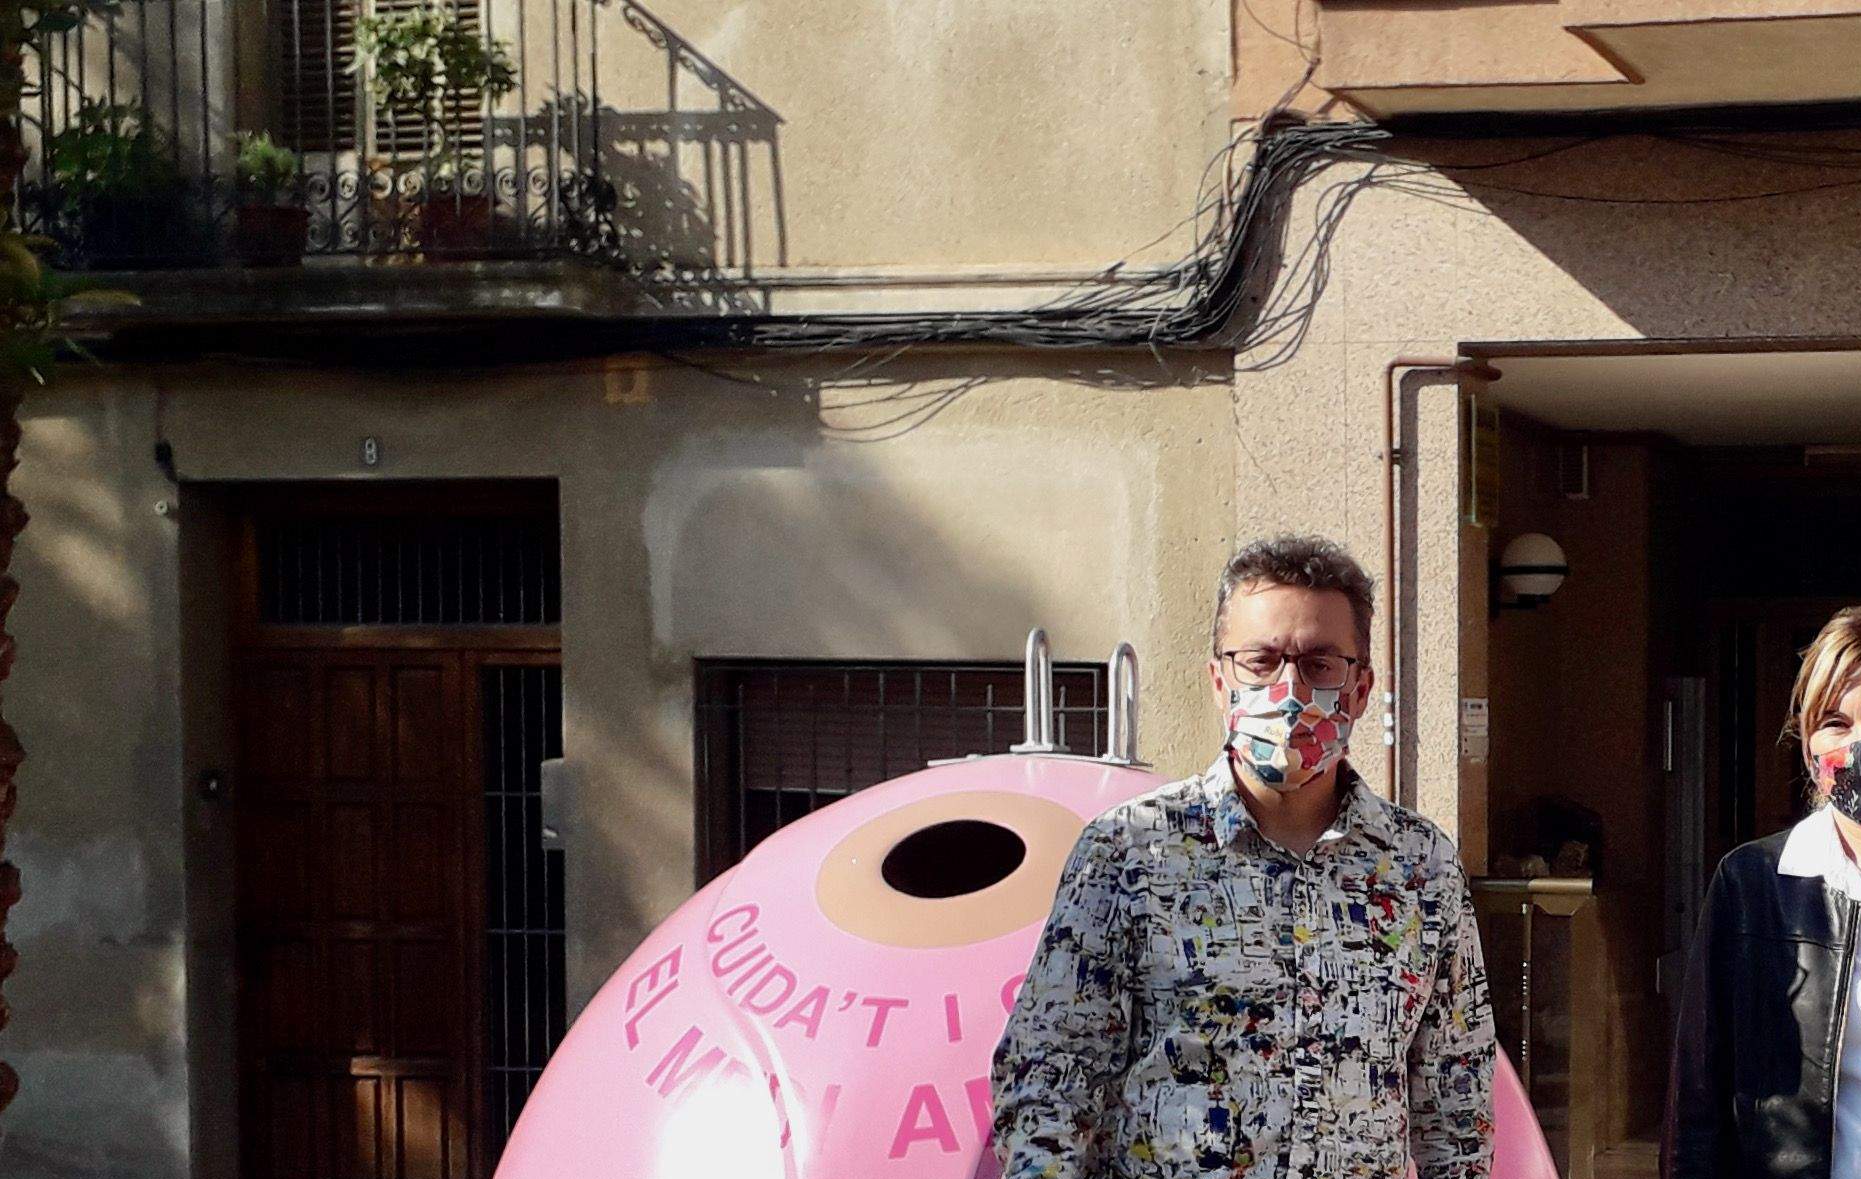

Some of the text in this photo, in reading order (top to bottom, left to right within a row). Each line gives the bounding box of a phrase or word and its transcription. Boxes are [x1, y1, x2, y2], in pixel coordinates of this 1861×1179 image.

[625, 944, 684, 1050] EL
[707, 903, 909, 1048] CUIDA'T
[944, 994, 962, 1043] I
